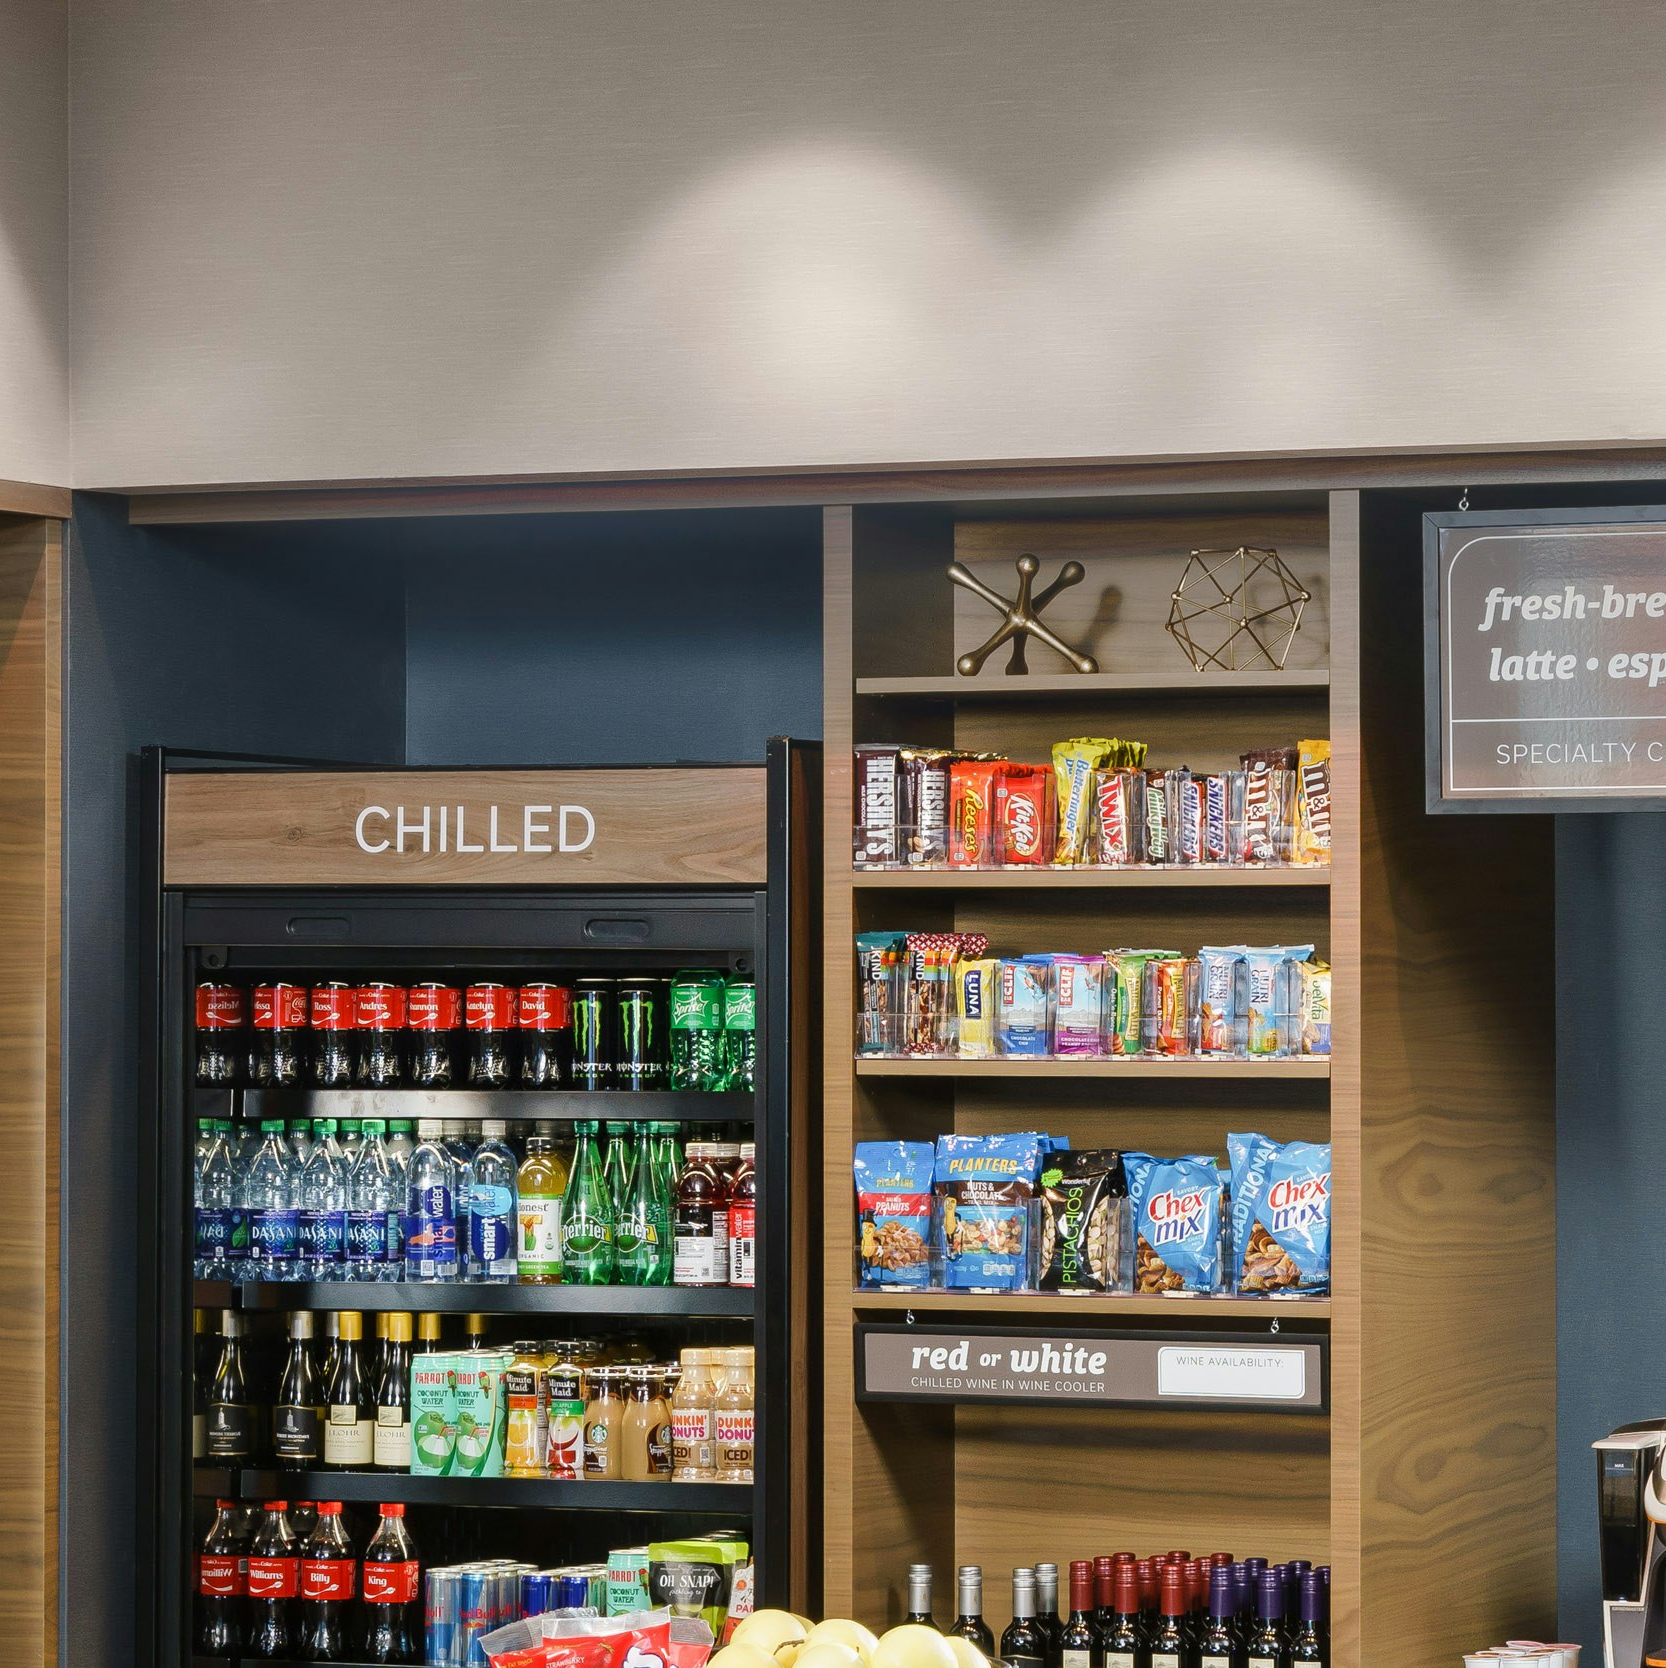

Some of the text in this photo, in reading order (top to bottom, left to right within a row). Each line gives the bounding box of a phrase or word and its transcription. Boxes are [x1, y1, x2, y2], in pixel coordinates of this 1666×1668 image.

[1489, 647, 1576, 682] latte
[1496, 742, 1635, 765] SPECIALTY
[1066, 759, 1089, 831] Butterfinger
[1099, 777, 1124, 851] TWIX
[1208, 778, 1224, 853] SNICKERS
[355, 805, 596, 854] CHILLED
[871, 950, 881, 980] KIND
[916, 950, 925, 980] KIND
[967, 975, 979, 1015] LUNA
[314, 1002, 332, 1011] Ross
[360, 1002, 387, 1011] Andres
[522, 1000, 545, 1010] David
[674, 1001, 704, 1016] Sprite
[949, 1158, 1018, 1175] PLANTERS
[967, 1181, 995, 1192] NUTS &
[1269, 1173, 1331, 1213] Chex
[1149, 1188, 1206, 1223] Chex
[1062, 1187, 1082, 1284] PISTACHIOS
[1154, 1215, 1205, 1245] mix
[912, 1341, 1107, 1374] red or white
[1176, 1356, 1284, 1368] WINE AVAILABILITY:
[415, 1372, 446, 1385] PARROT
[549, 1379, 576, 1389] Minute
[911, 1377, 1105, 1392] CHILLED WINE IN WINE COOLER
[417, 1389, 449, 1398] COCONUT
[508, 1383, 529, 1392] Maid
[551, 1387, 573, 1396] Maid
[250, 1569, 283, 1580] Williams
[311, 1572, 330, 1585] Billy
[368, 1575, 388, 1587] King
[609, 1570, 636, 1582] PARROT
[660, 1574, 715, 1588] OH SNAP!
[610, 1588, 639, 1596] COCONUT
